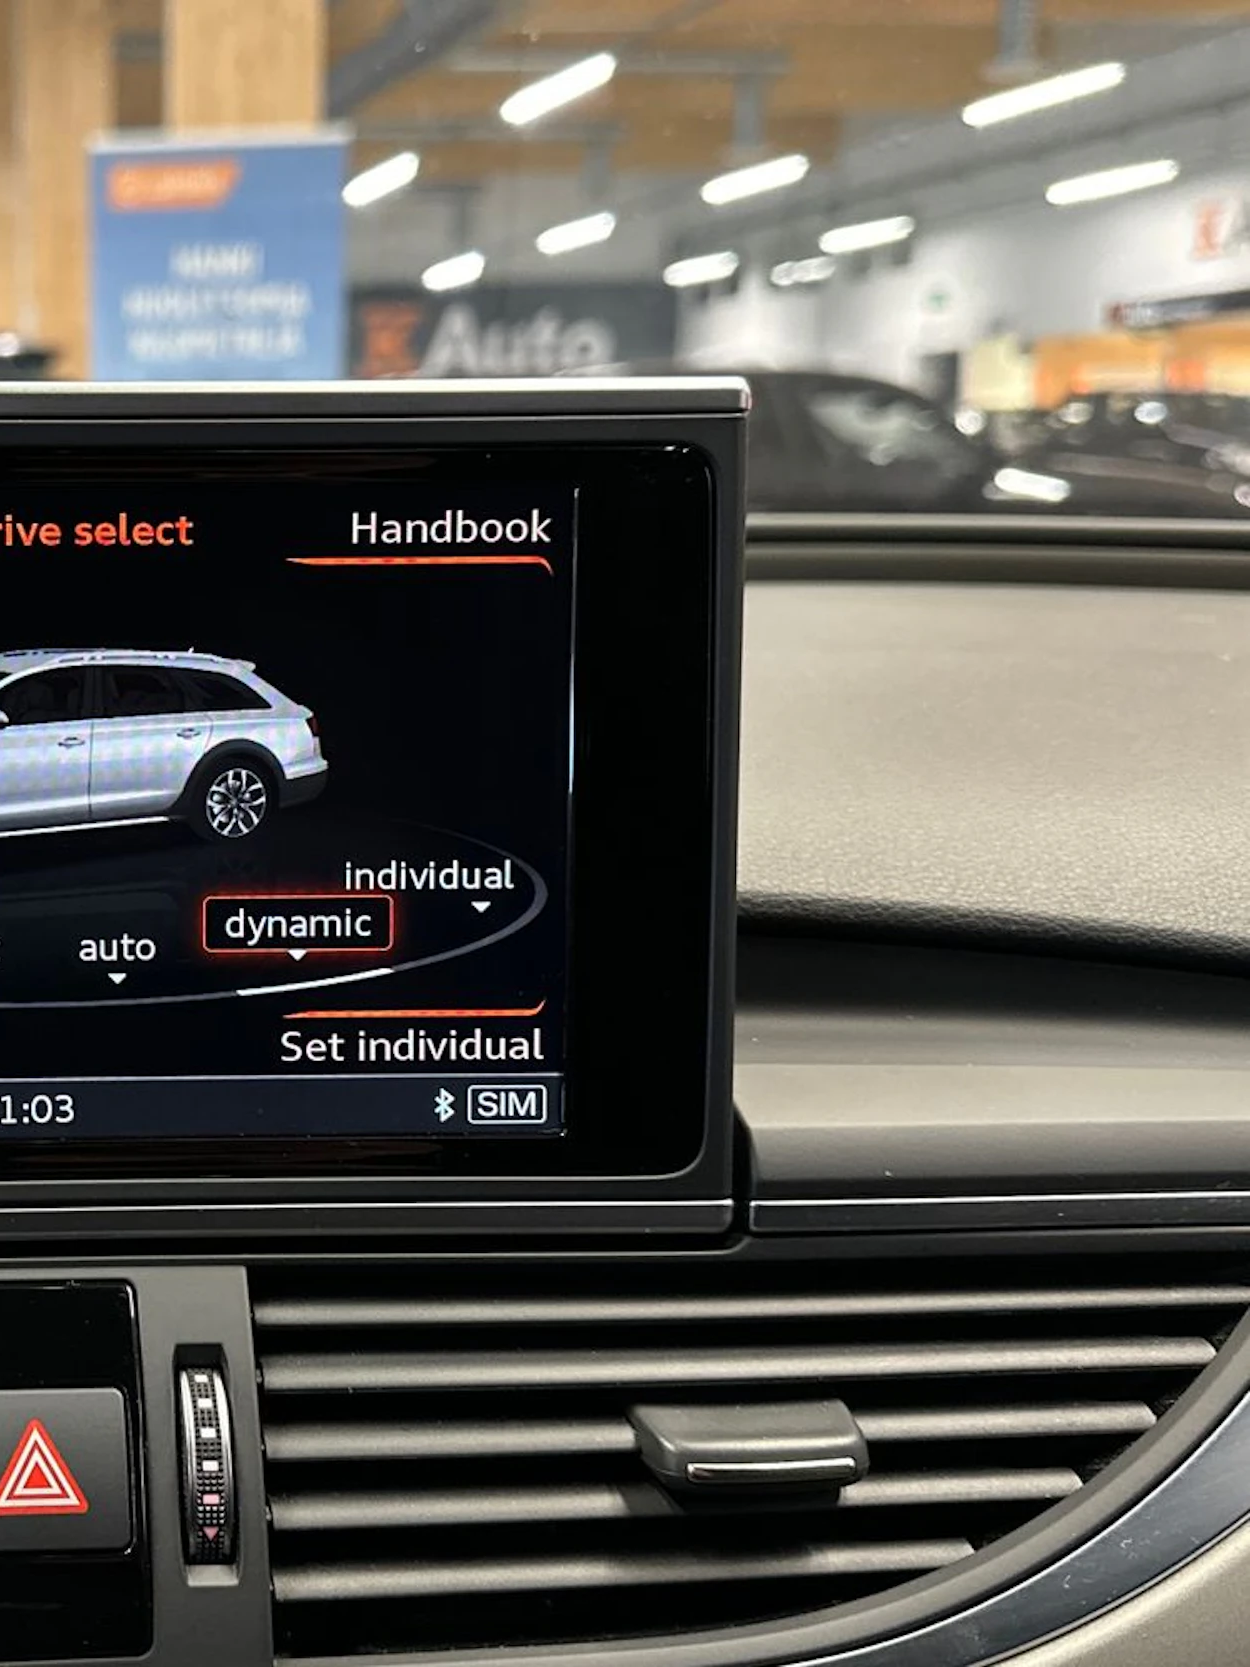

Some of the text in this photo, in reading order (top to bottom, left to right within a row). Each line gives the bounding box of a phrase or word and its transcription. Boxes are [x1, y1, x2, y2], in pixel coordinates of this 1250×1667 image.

[74, 511, 194, 547] select
[352, 507, 552, 545] Handbook
[345, 859, 516, 891] individual
[224, 907, 373, 947] dynamic
[79, 933, 157, 963] auto
[280, 1027, 546, 1063] Set individual
[477, 1090, 537, 1118] SIM
